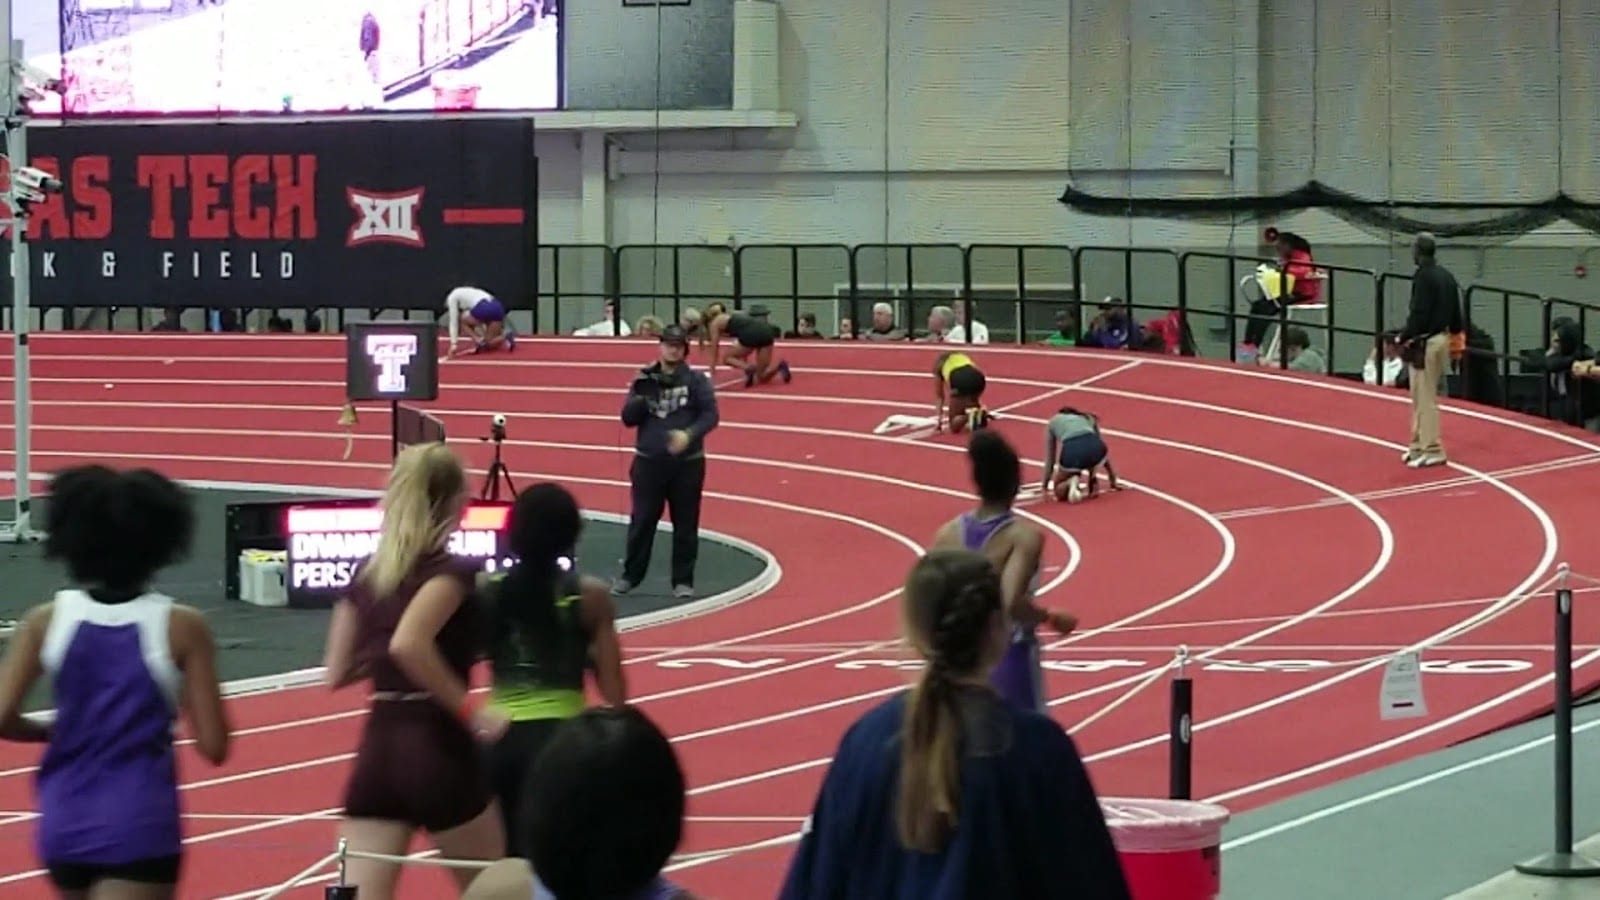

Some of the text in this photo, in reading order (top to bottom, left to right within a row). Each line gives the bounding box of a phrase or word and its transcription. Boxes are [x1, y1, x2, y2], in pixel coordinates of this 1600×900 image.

[137, 154, 317, 240] TECH
[351, 193, 420, 240] XII
[101, 251, 117, 278] &
[162, 251, 294, 278] FIELD
[293, 561, 358, 588] PERS
[657, 658, 784, 668] 2
